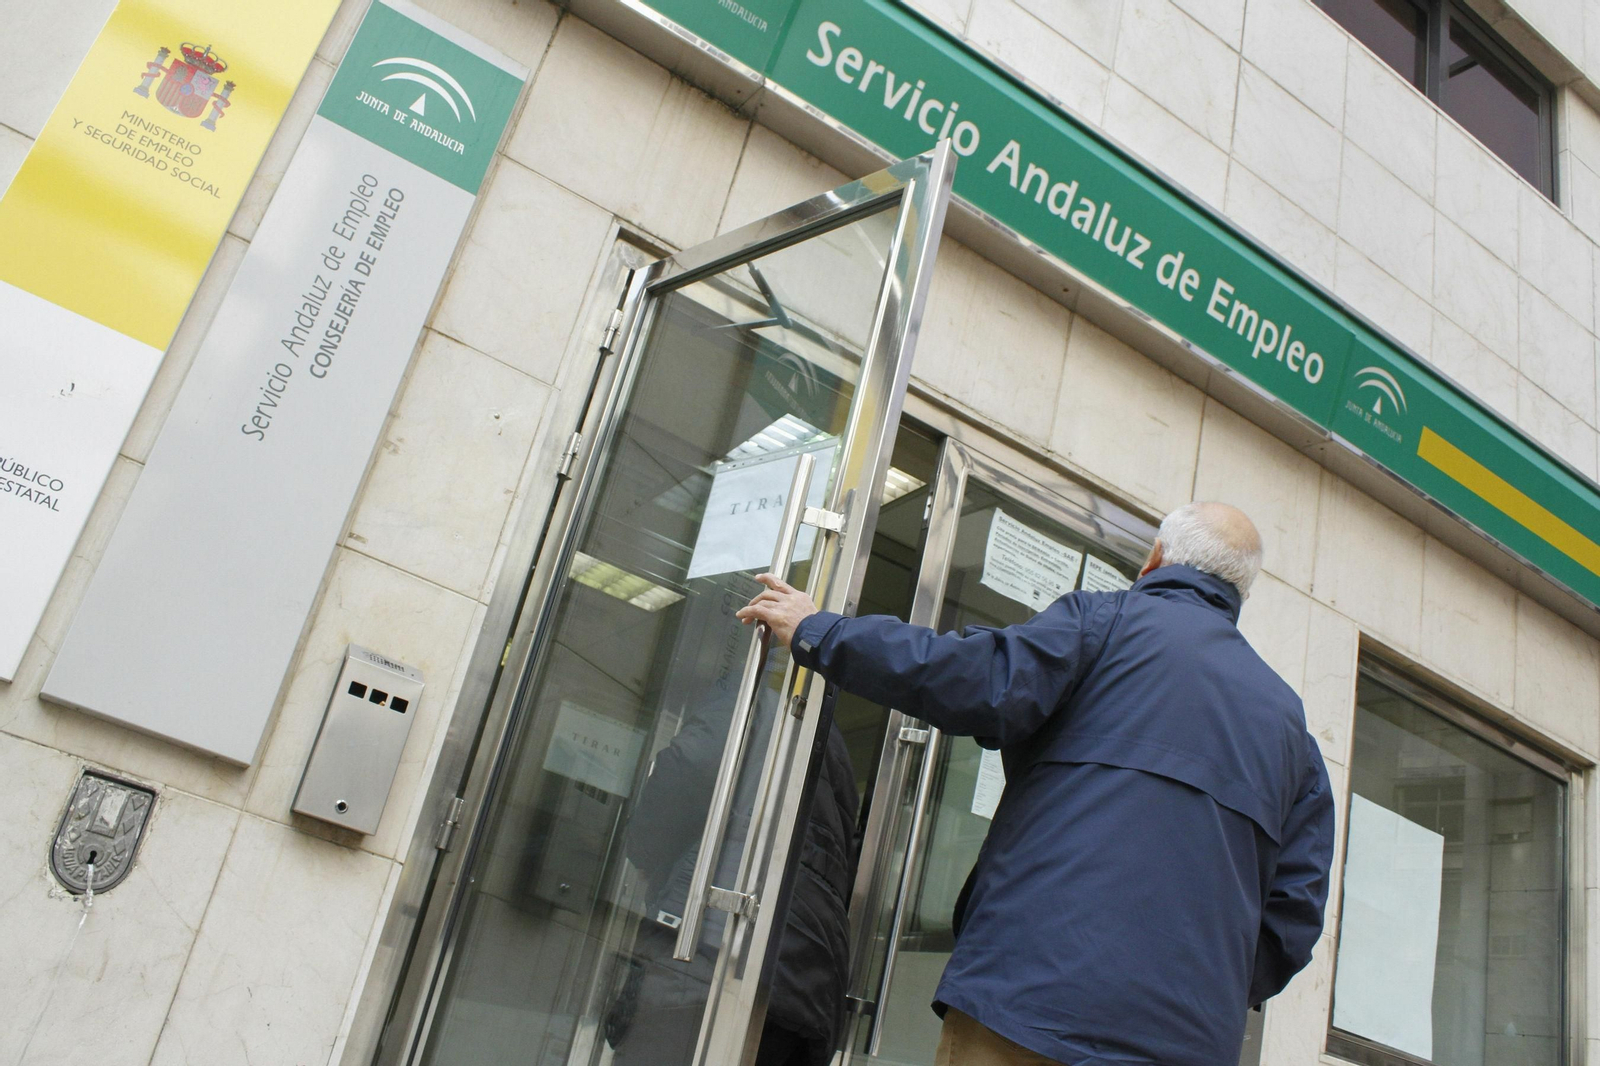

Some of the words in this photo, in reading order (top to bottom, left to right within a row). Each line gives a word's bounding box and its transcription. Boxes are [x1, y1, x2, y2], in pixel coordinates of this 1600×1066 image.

[115, 124, 136, 141] DE
[138, 135, 194, 168] EMPLEO
[121, 110, 202, 156] MINISTERIO
[356, 91, 389, 115] JUNTA
[393, 108, 408, 125] DE
[410, 118, 465, 155] ANDALUCIA
[72, 118, 83, 129] Y
[84, 125, 168, 171] SEGURIDAD
[170, 167, 221, 199] SOCIAL
[332, 174, 378, 242] Empleo
[806, 21, 980, 156] Servicio
[986, 139, 1151, 270] Andaluz
[1156, 251, 1200, 301] de
[1206, 277, 1324, 384] Empleo
[310, 279, 365, 379] CONSEJERÍA
[354, 251, 377, 277] DE
[366, 187, 405, 251] EMPLEO
[321, 245, 346, 271] de
[281, 274, 333, 358] Andaluz
[241, 362, 293, 441] Servicio
[572, 732, 621, 757] TIRAR
